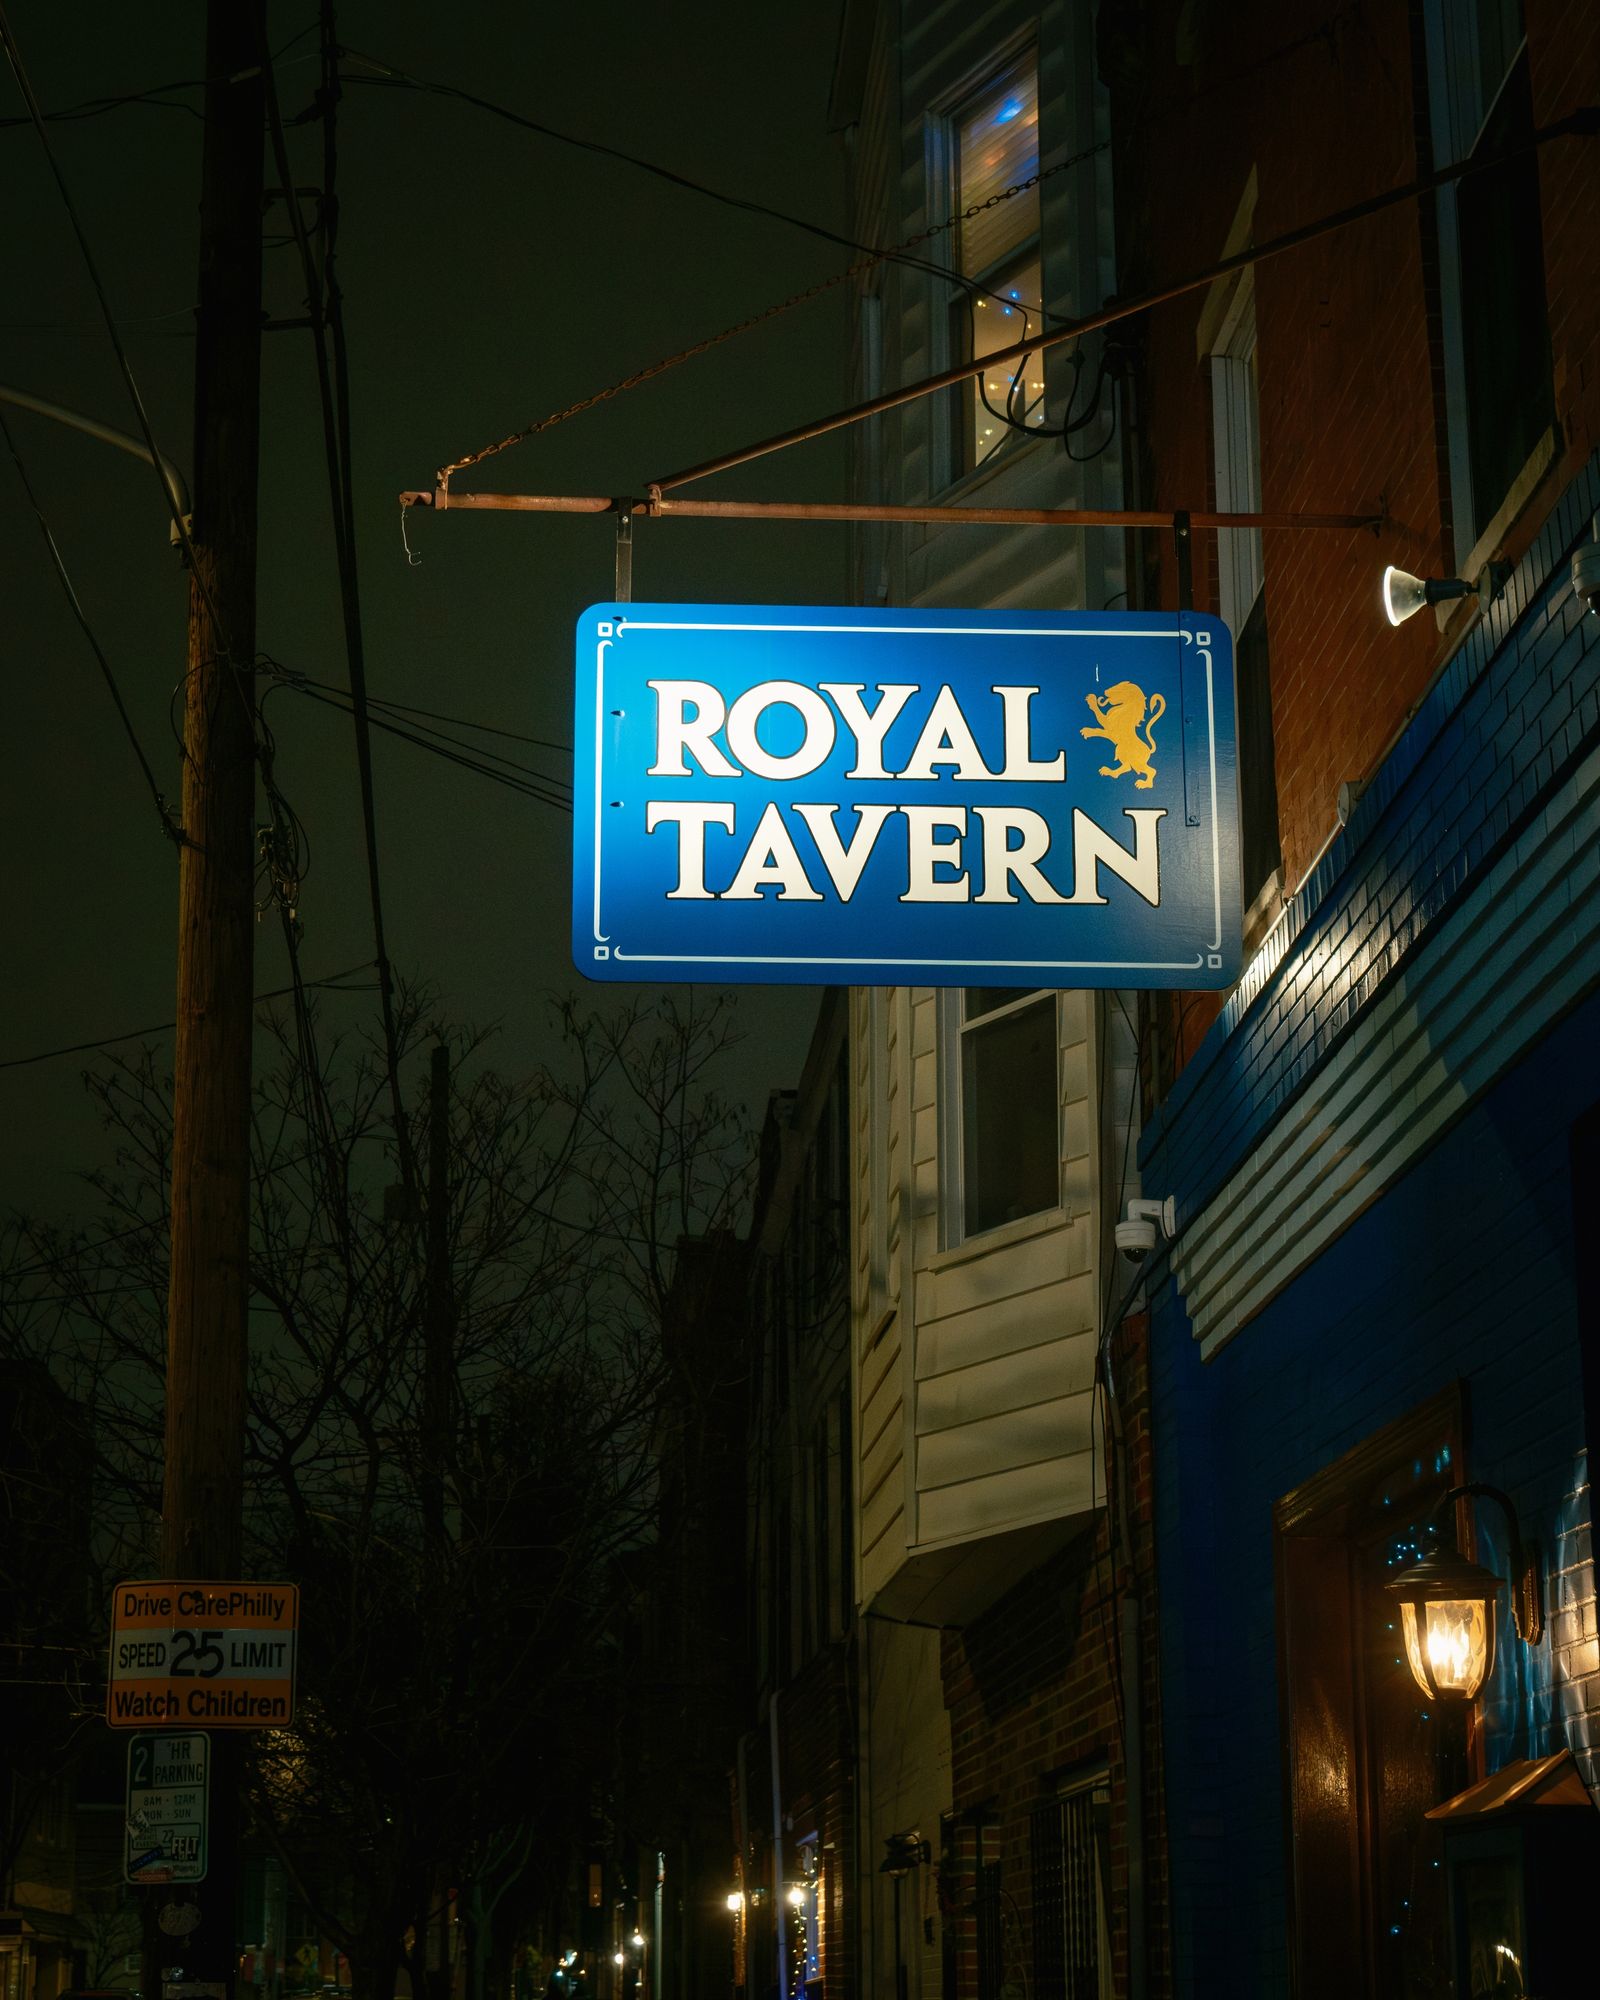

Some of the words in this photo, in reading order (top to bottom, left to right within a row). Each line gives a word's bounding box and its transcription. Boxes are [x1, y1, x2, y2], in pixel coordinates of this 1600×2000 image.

[646, 679, 1066, 783] ROYAL
[646, 801, 1168, 908] TAVERN
[124, 1592, 172, 1617] Drive
[178, 1590, 286, 1621] CarePhilly
[119, 1642, 166, 1668] SPEED
[169, 1630, 224, 1678] 25
[231, 1642, 287, 1668] LIMIT
[115, 1689, 179, 1718] Watch
[187, 1689, 286, 1718] Children
[134, 1746, 149, 1783] 2
[171, 1741, 191, 1760] HR
[154, 1763, 203, 1784] PARKING
[174, 1808, 192, 1818] SUN
